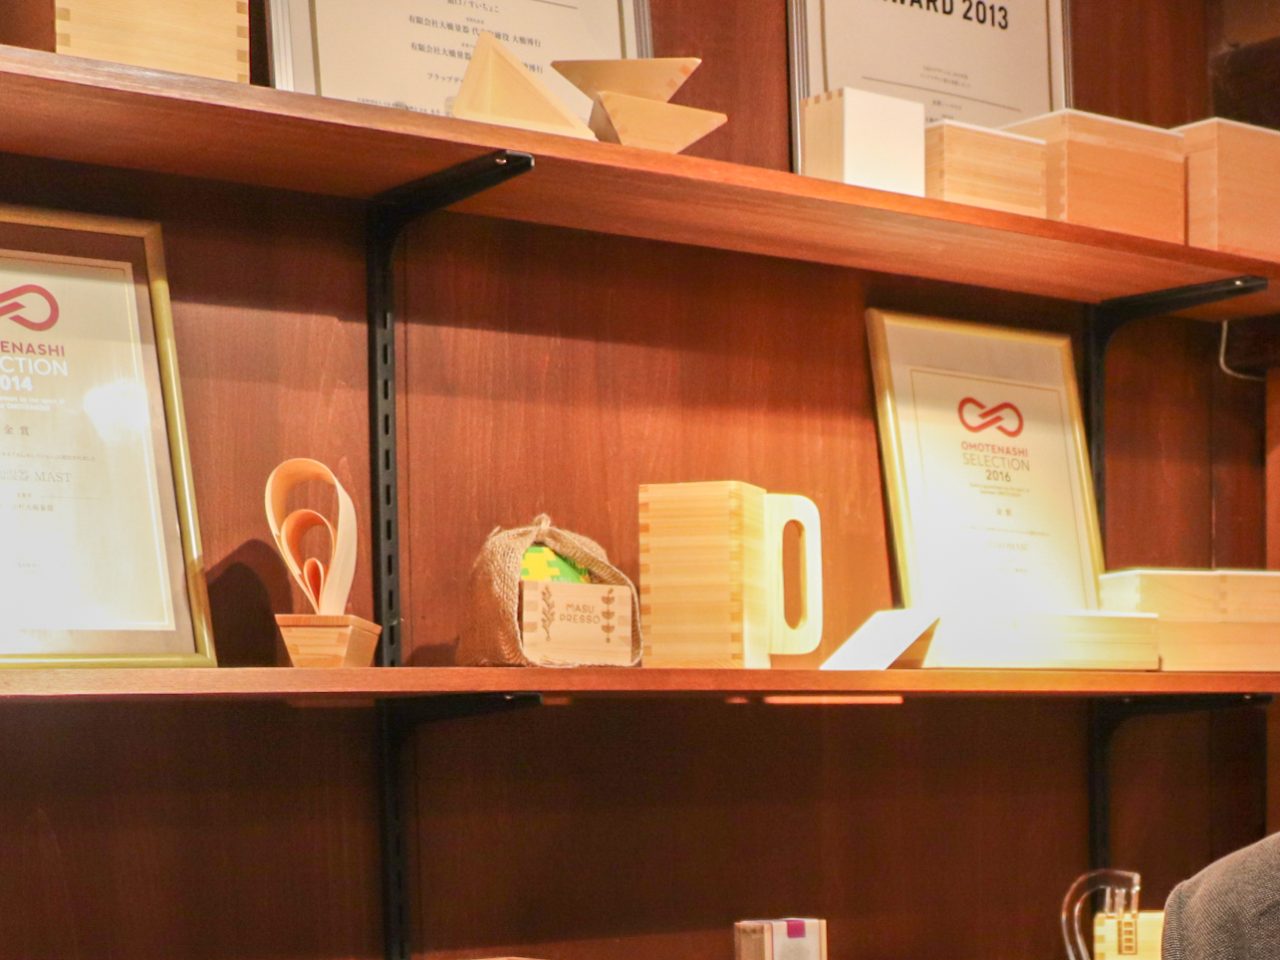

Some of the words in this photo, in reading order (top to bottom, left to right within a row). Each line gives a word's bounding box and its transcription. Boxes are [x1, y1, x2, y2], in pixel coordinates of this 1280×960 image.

[961, 0, 1009, 30] 2013
[0, 340, 66, 357] ENASHI
[0, 356, 69, 377] CTION
[960, 441, 1029, 457] OMOTENASHI
[962, 453, 1031, 472] SELECTION
[985, 469, 1012, 483] 2016
[566, 603, 595, 614] MASU
[559, 614, 601, 625] PRESSO
